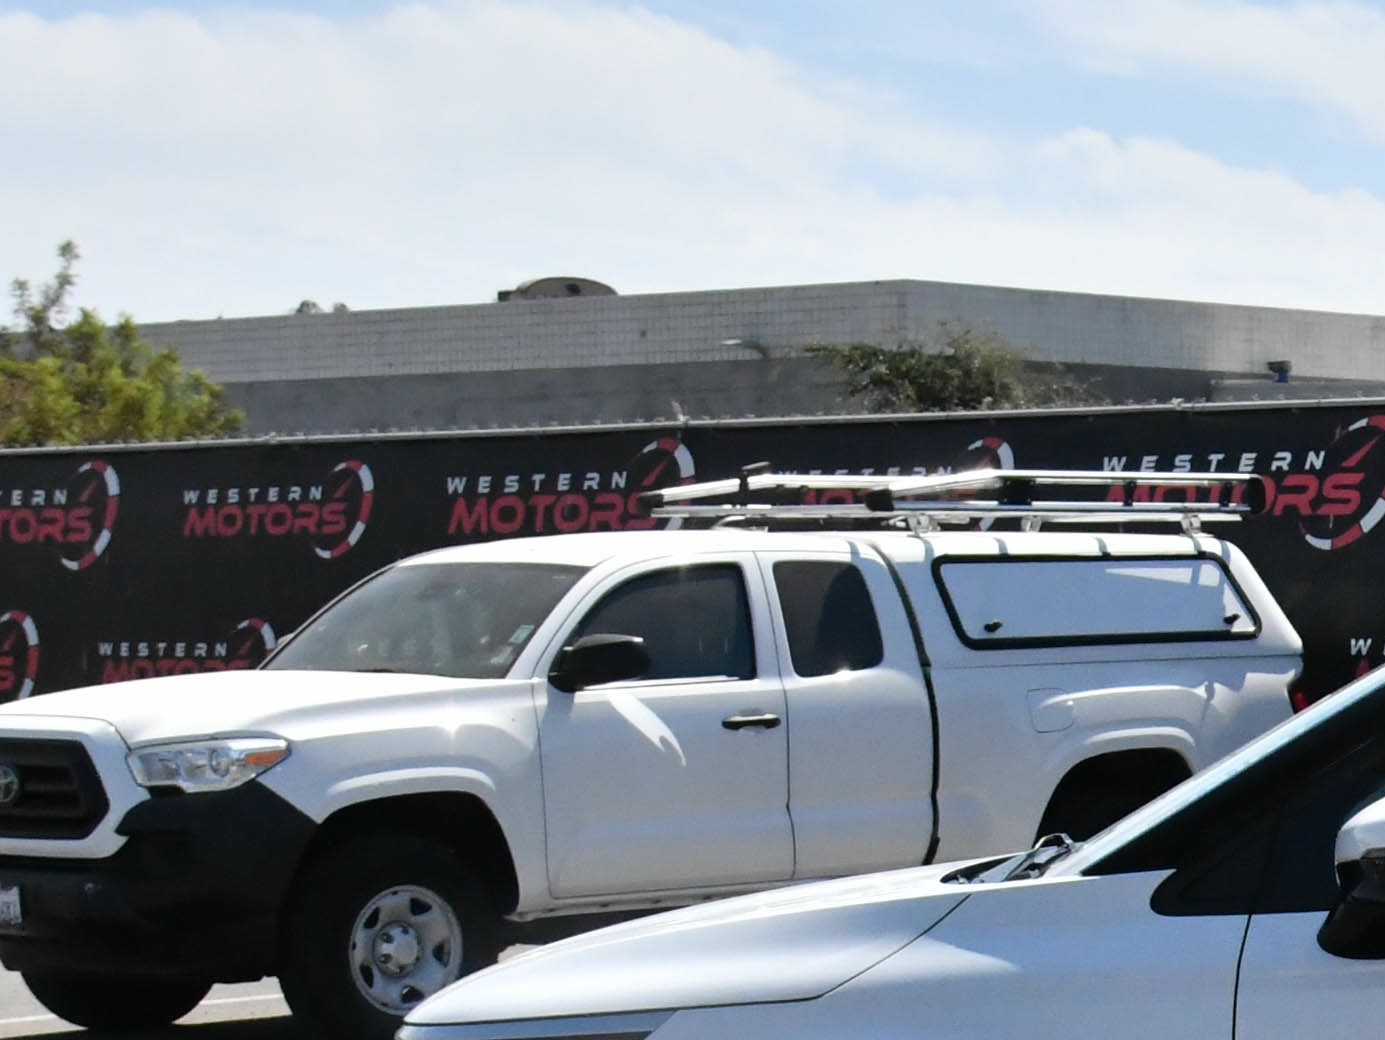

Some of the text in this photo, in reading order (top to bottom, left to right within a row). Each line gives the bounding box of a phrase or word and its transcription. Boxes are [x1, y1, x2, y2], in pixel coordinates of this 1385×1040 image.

[1103, 450, 1326, 473] WESTERN
[447, 471, 629, 495] WESTERN
[0, 488, 68, 506] ERN
[183, 485, 322, 504] WESTERN
[183, 502, 347, 537] MOTORS
[98, 641, 228, 658] WESTERN
